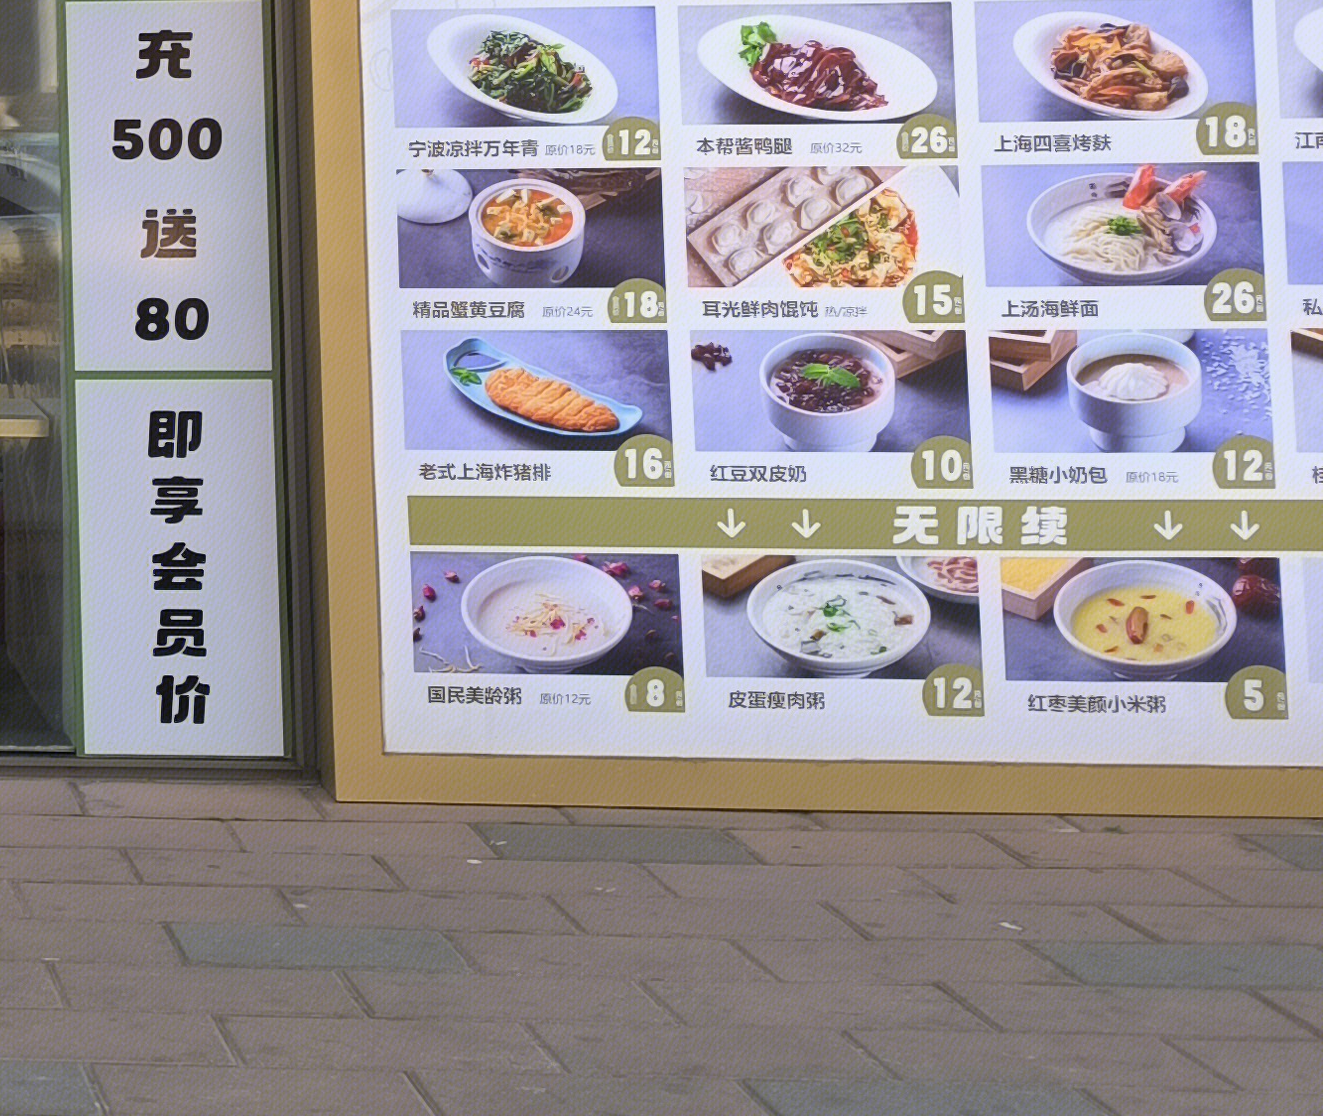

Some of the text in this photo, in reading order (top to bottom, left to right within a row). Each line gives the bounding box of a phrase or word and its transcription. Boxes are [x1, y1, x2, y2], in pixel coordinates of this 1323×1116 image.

[136, 30, 193, 79] 充
[112, 118, 222, 160] 500
[619, 129, 651, 155] 12
[696, 137, 793, 156] 本帮酱鸭腿
[911, 126, 948, 154] 26
[1205, 115, 1247, 148] 18
[408, 139, 539, 158] 宁波凉拌万年青
[140, 209, 197, 259] 送
[624, 290, 657, 318] 18
[914, 284, 952, 316] 15
[1001, 299, 1099, 318] 上汤海鲜面
[1212, 281, 1255, 314] 26
[135, 297, 210, 340] 80
[419, 462, 551, 481] 老式上海炸猪排
[624, 447, 664, 480] 16
[709, 464, 807, 483] 红豆双皮奶
[921, 449, 963, 482] 10
[1223, 449, 1264, 481] 12
[893, 505, 1068, 545] 无限续
[148, 410, 211, 725] 即享会员价
[646, 678, 665, 707] 8
[728, 690, 826, 710] 皮蛋瘦肉粥
[933, 677, 973, 709] 12
[1027, 693, 1167, 714] 红枣美颜小米粥
[1242, 679, 1264, 711] 5
